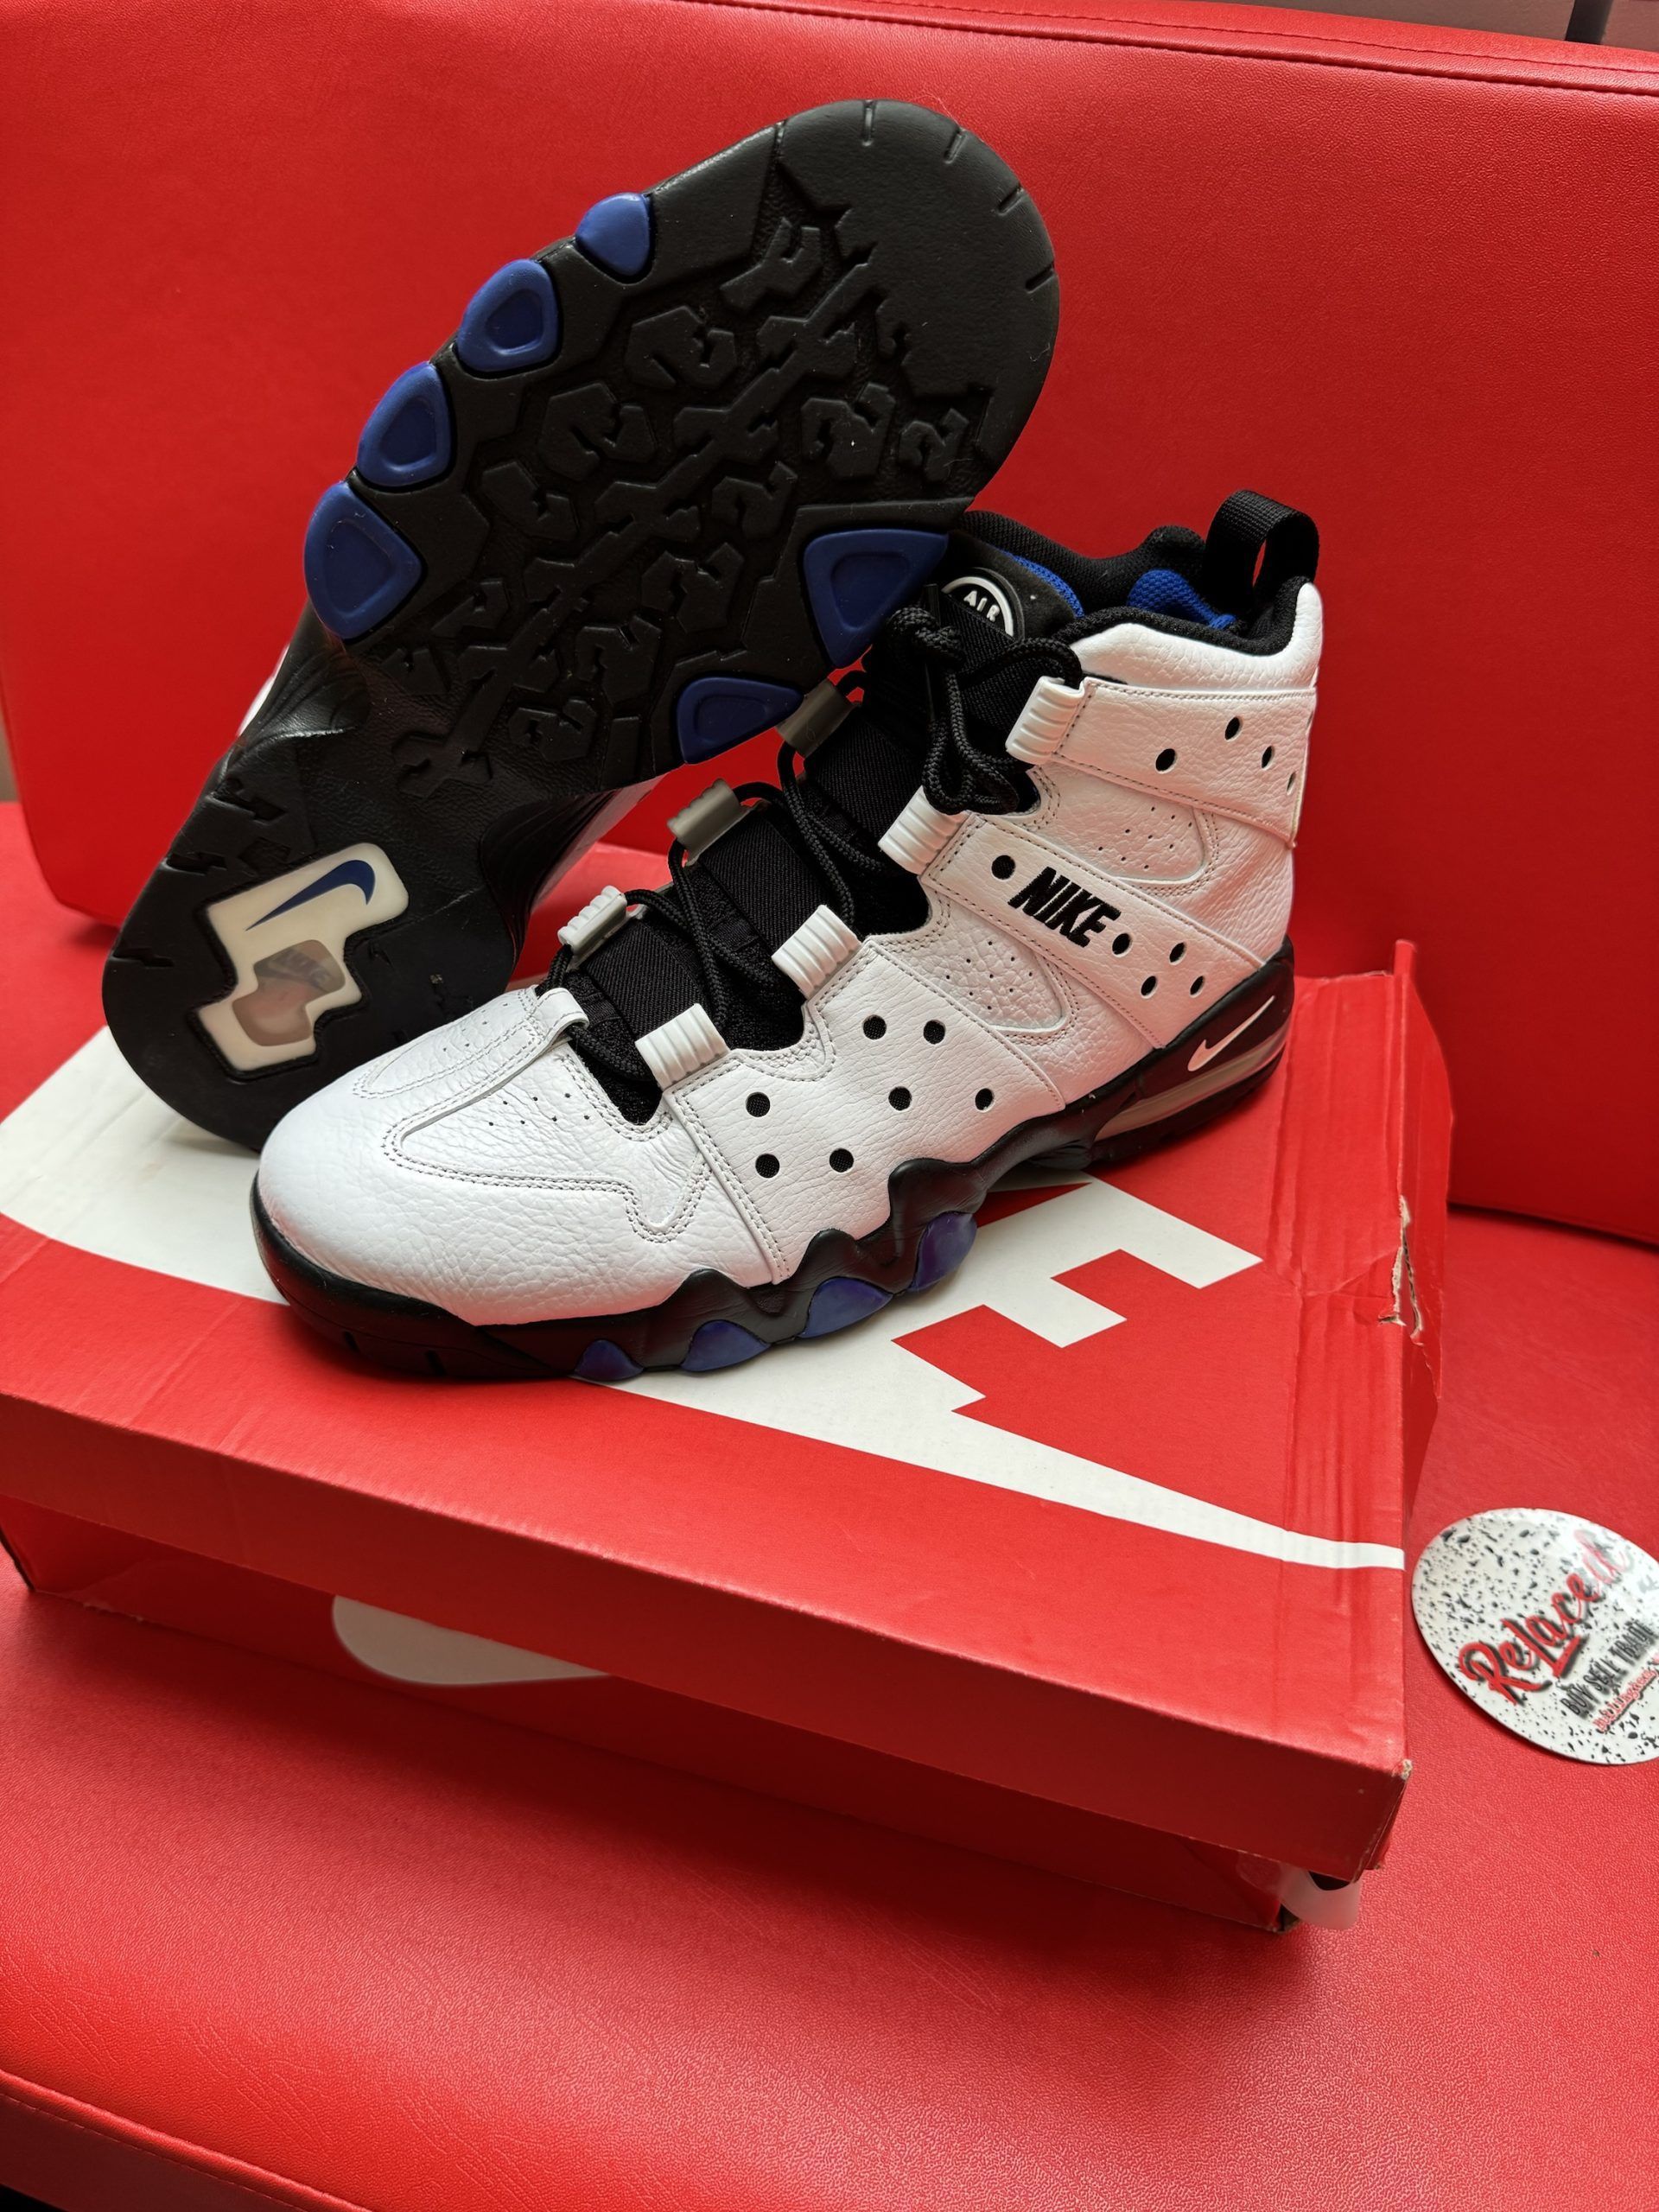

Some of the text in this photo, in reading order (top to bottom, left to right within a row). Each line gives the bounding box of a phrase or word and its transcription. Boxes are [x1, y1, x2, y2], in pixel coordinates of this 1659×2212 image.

[963, 590, 1001, 622] AIR
[1007, 866, 1122, 948] NIKE
[1560, 1621, 1657, 1718] BUY SELL TRADE
